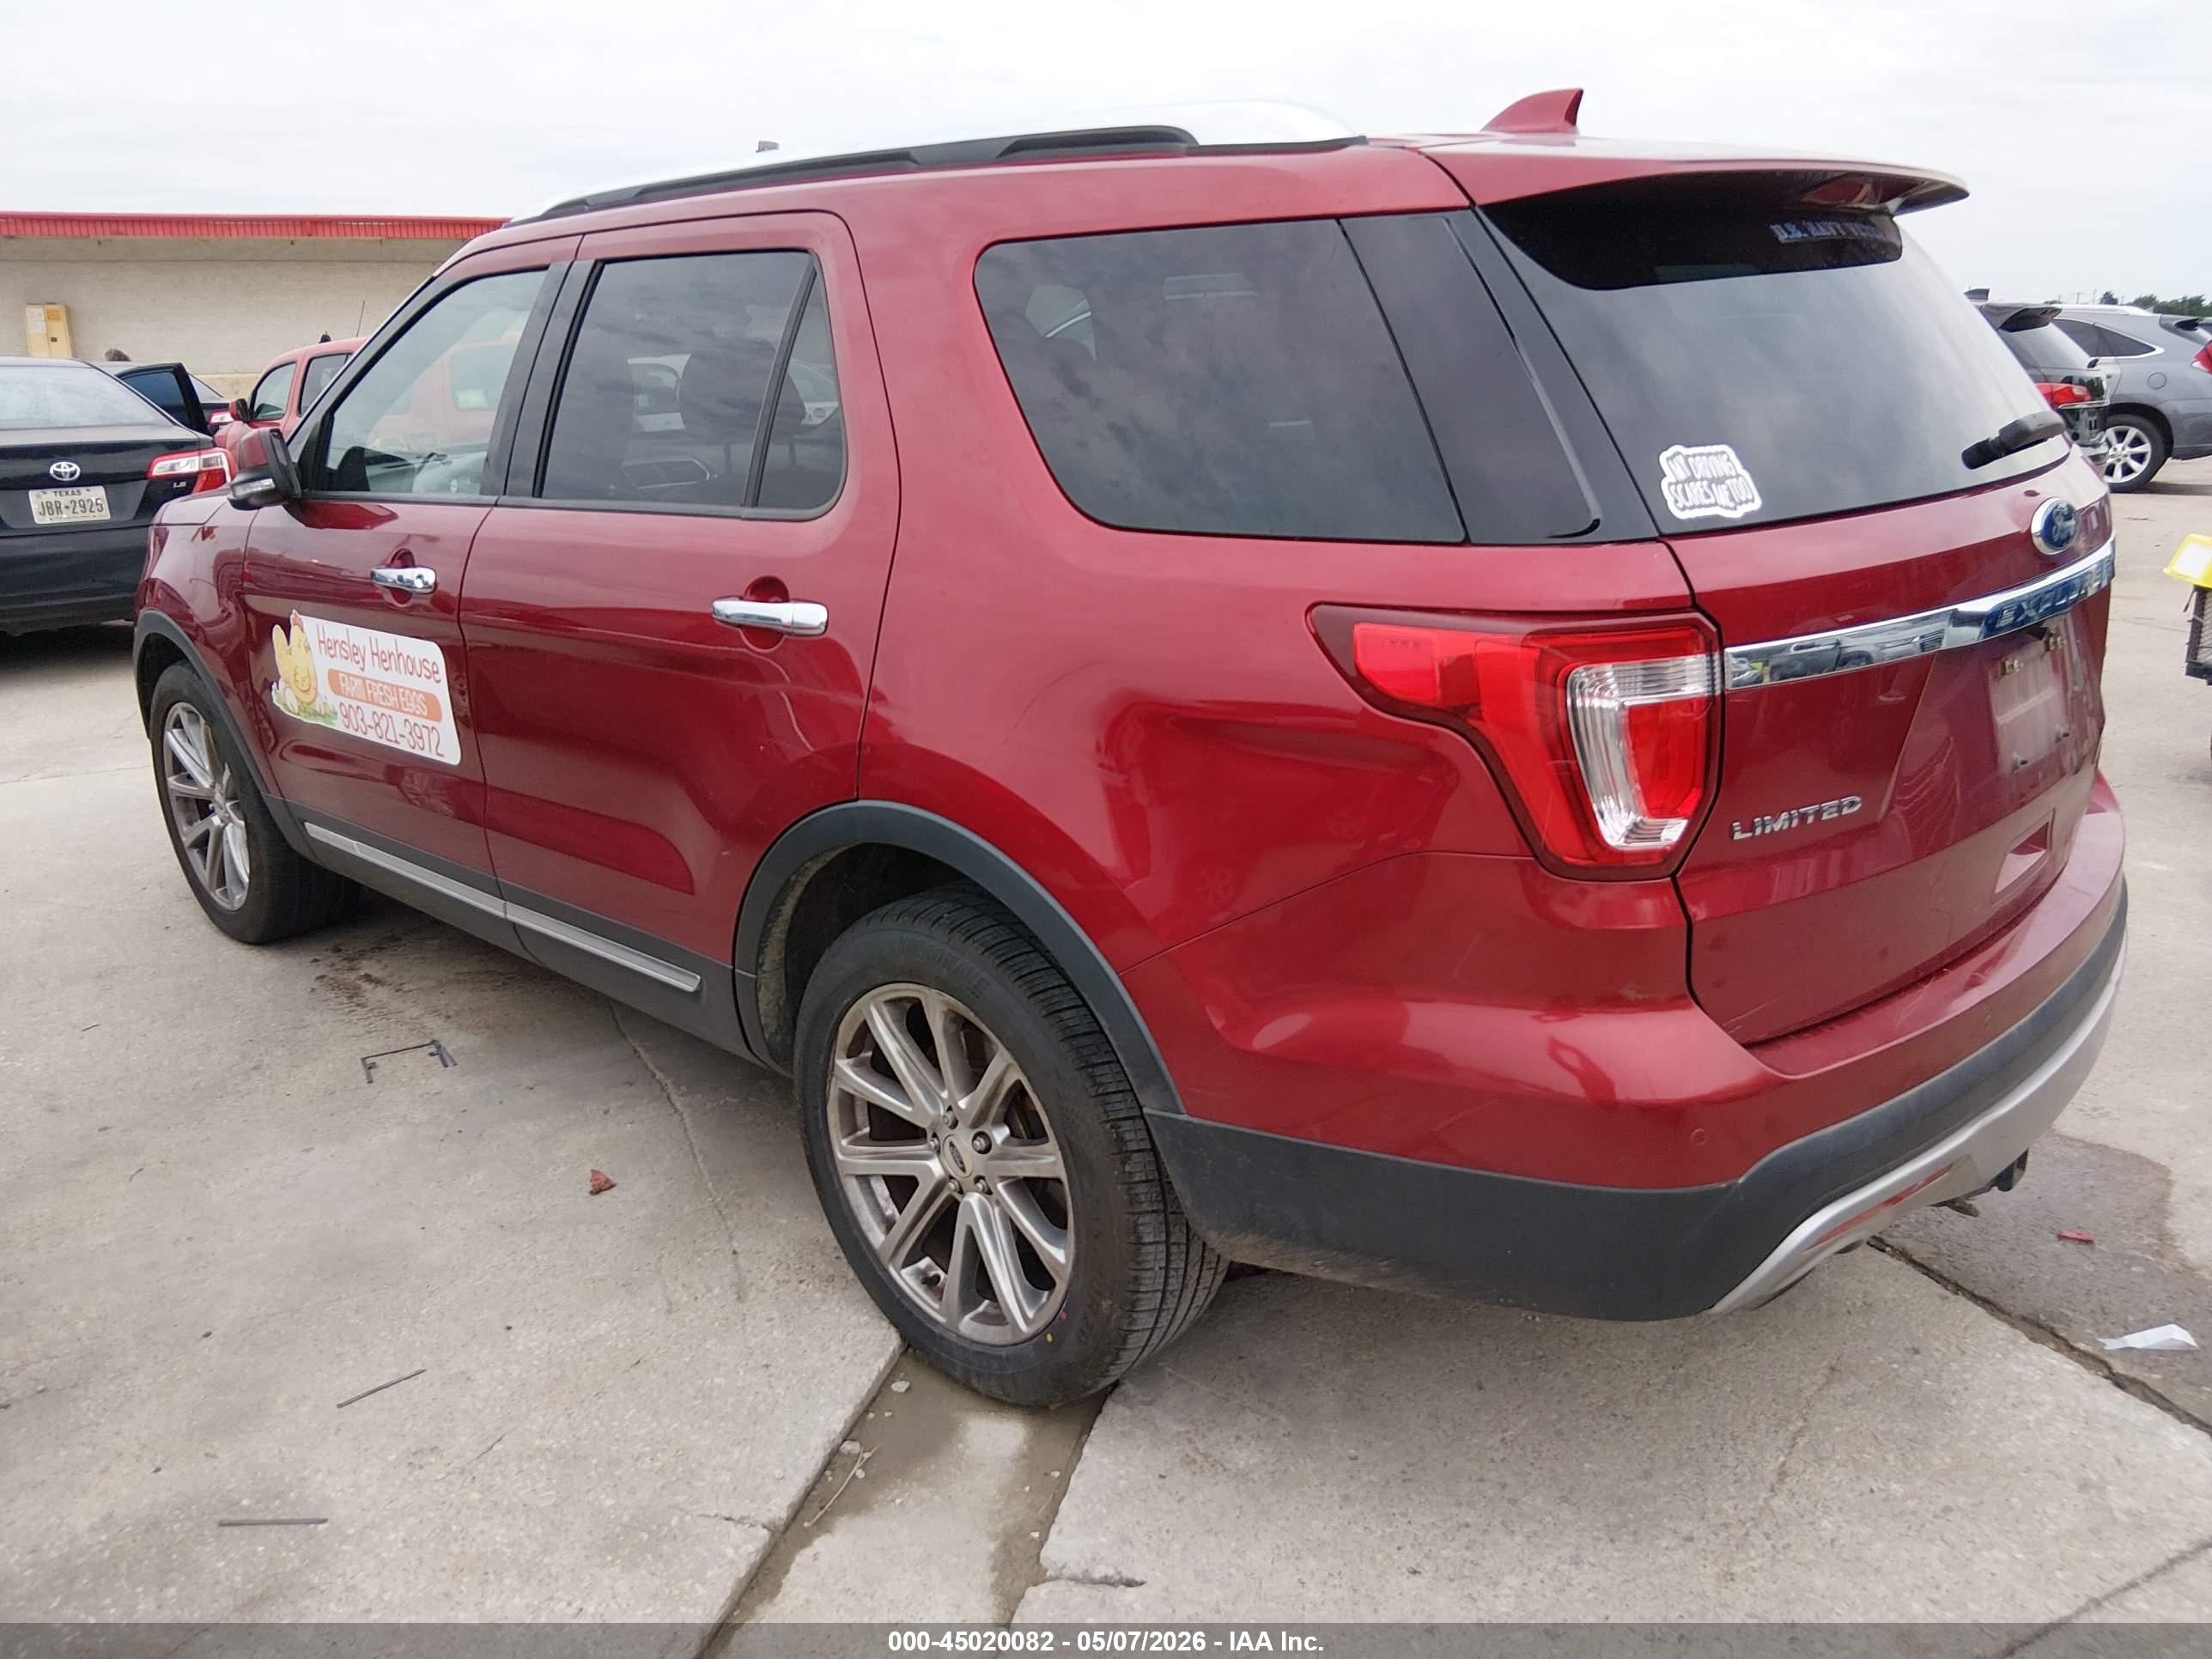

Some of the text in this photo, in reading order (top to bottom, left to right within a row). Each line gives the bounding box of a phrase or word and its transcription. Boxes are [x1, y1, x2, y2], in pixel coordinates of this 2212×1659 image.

[1668, 453, 1737, 481] MY DRIVING
[1669, 476, 1753, 508] SCARES ME TOO
[316, 623, 442, 684] Hensley Henhouse
[367, 679, 398, 709] FRESH
[398, 687, 428, 716] EGGS
[339, 702, 445, 757] 903-821-3972
[1731, 795, 1863, 841] LIMITED
